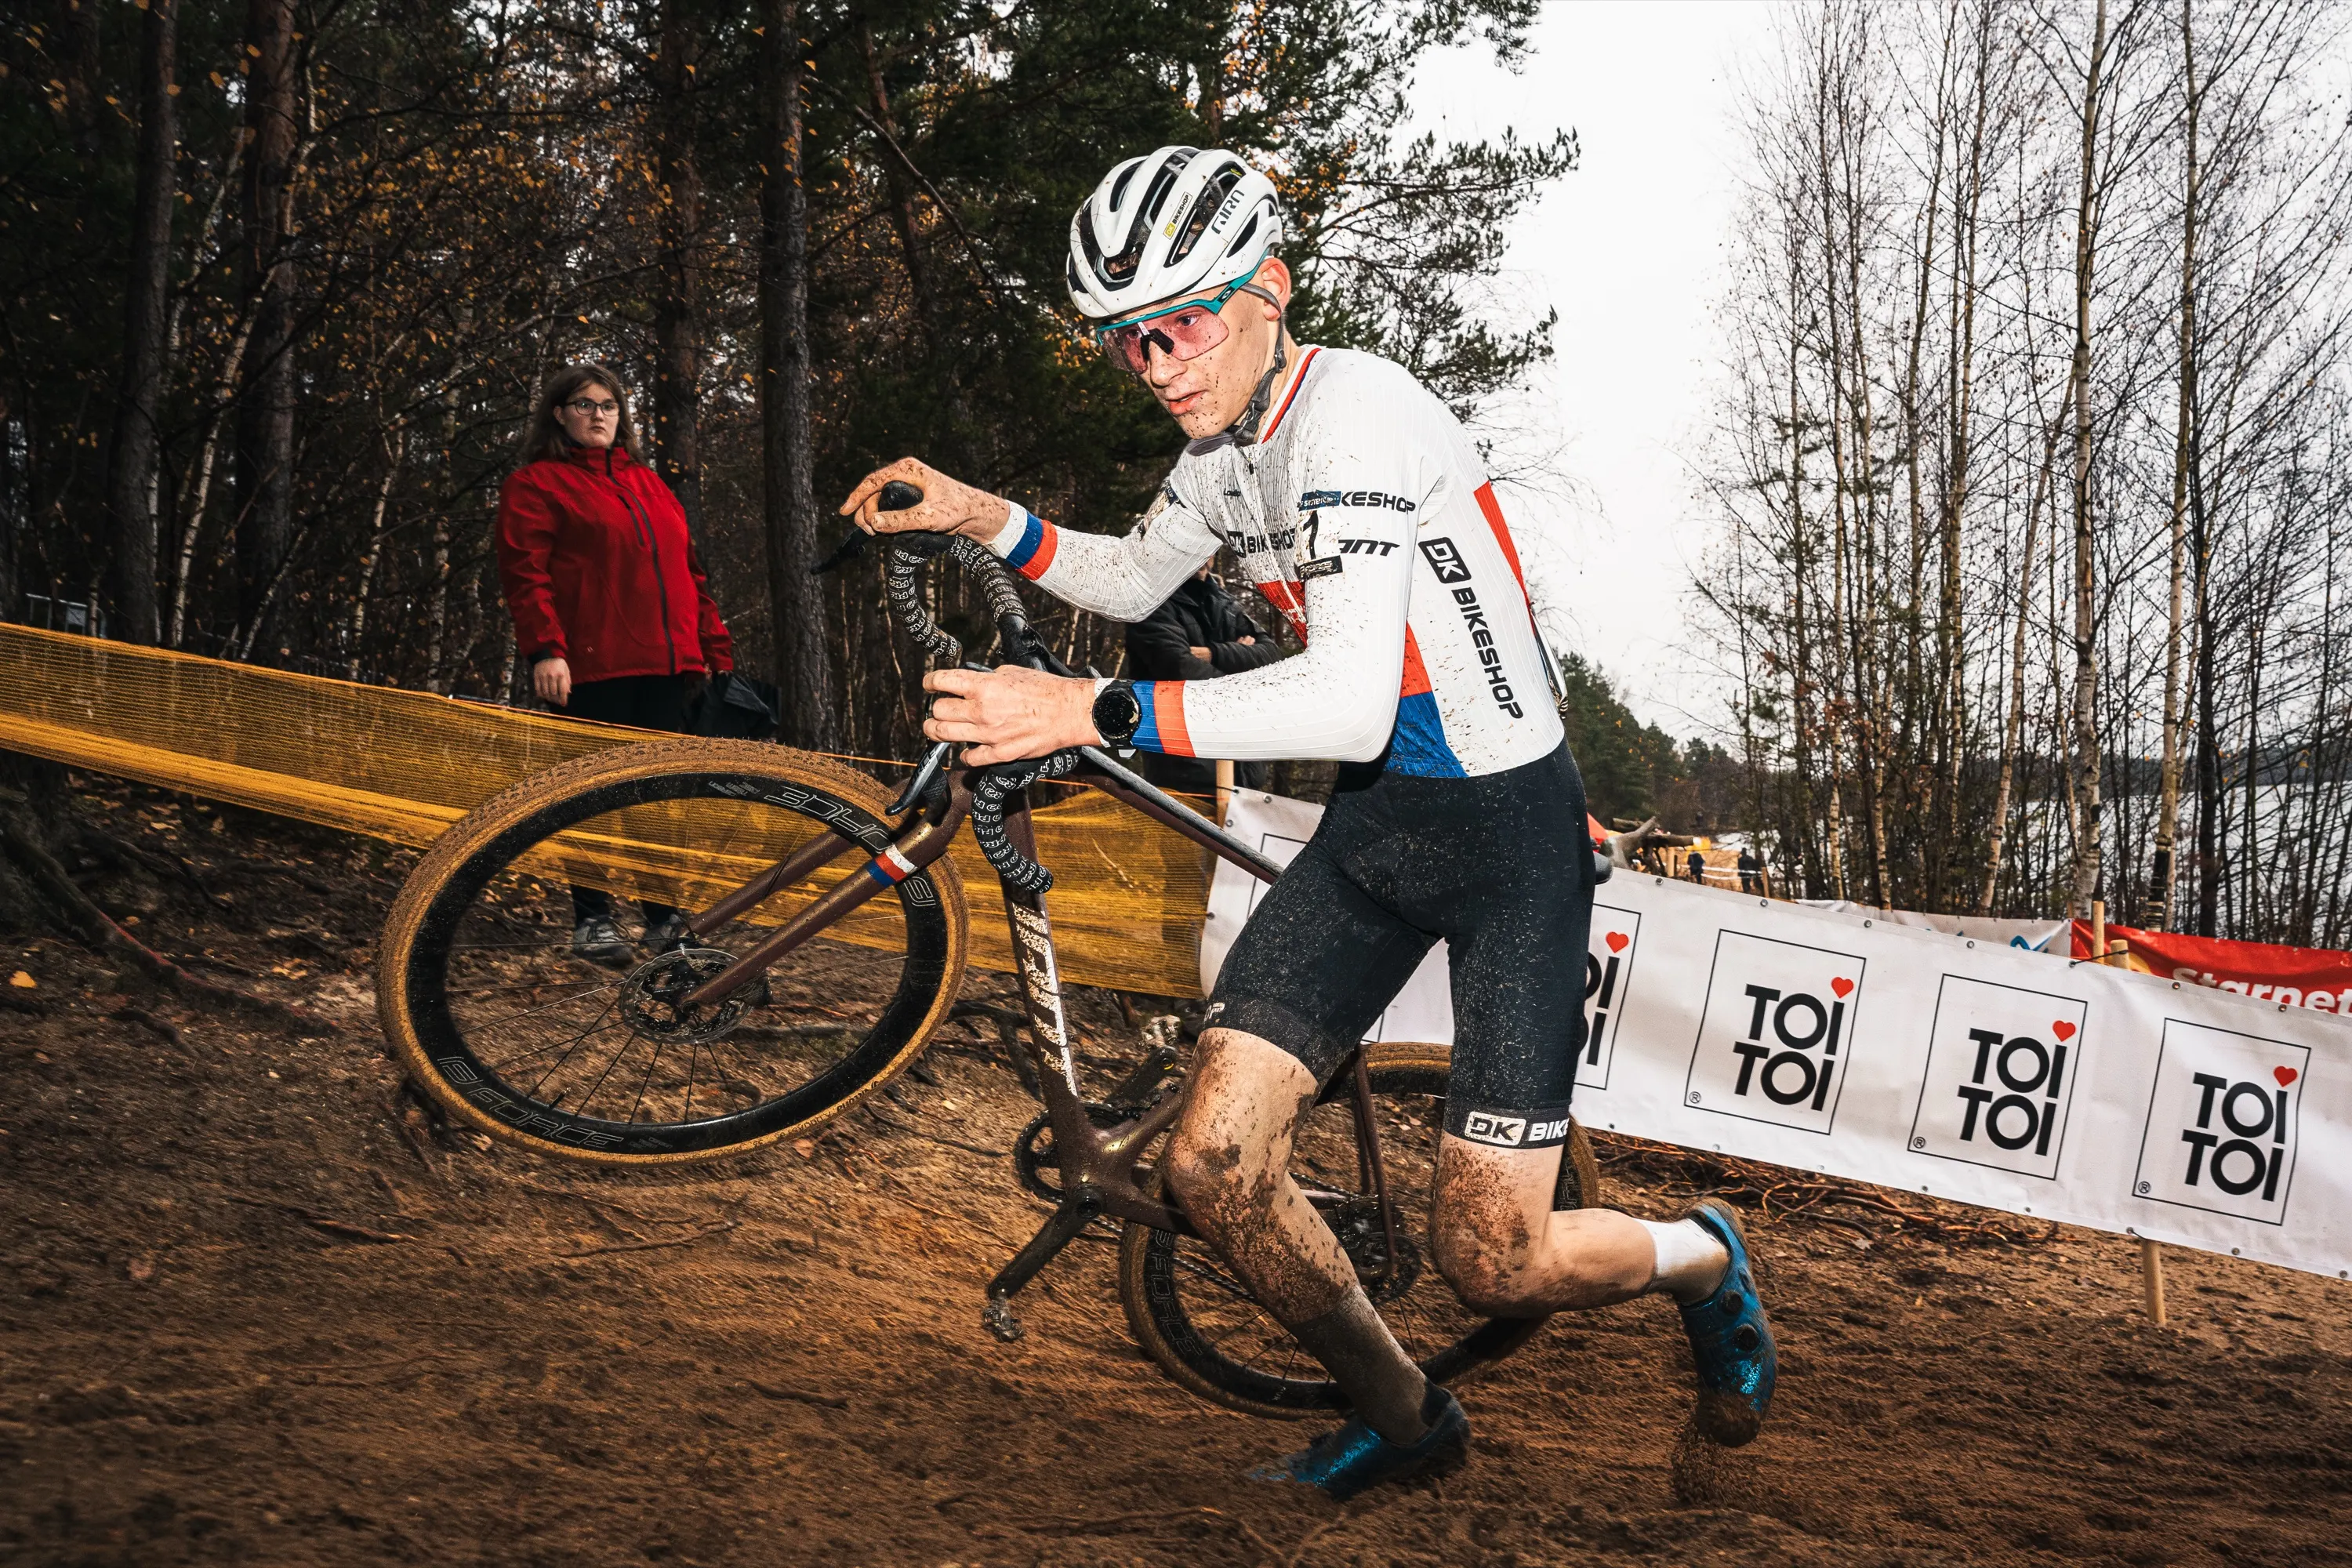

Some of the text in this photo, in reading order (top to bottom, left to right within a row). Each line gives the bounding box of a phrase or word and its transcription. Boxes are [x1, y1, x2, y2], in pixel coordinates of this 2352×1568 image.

[1171, 194, 1189, 224] BIKESHOP
[1426, 543, 1524, 719] DK BIKESHOP
[764, 786, 891, 854] ORCE
[1744, 983, 1845, 1056] TOI
[1733, 1041, 1835, 1111] TOI
[1969, 1028, 2067, 1098] TOI
[1470, 1116, 1519, 1141] DK
[1957, 1085, 2056, 1156] TOI
[2194, 1072, 2288, 1145] TOI
[2181, 1129, 2285, 1202] TOI
